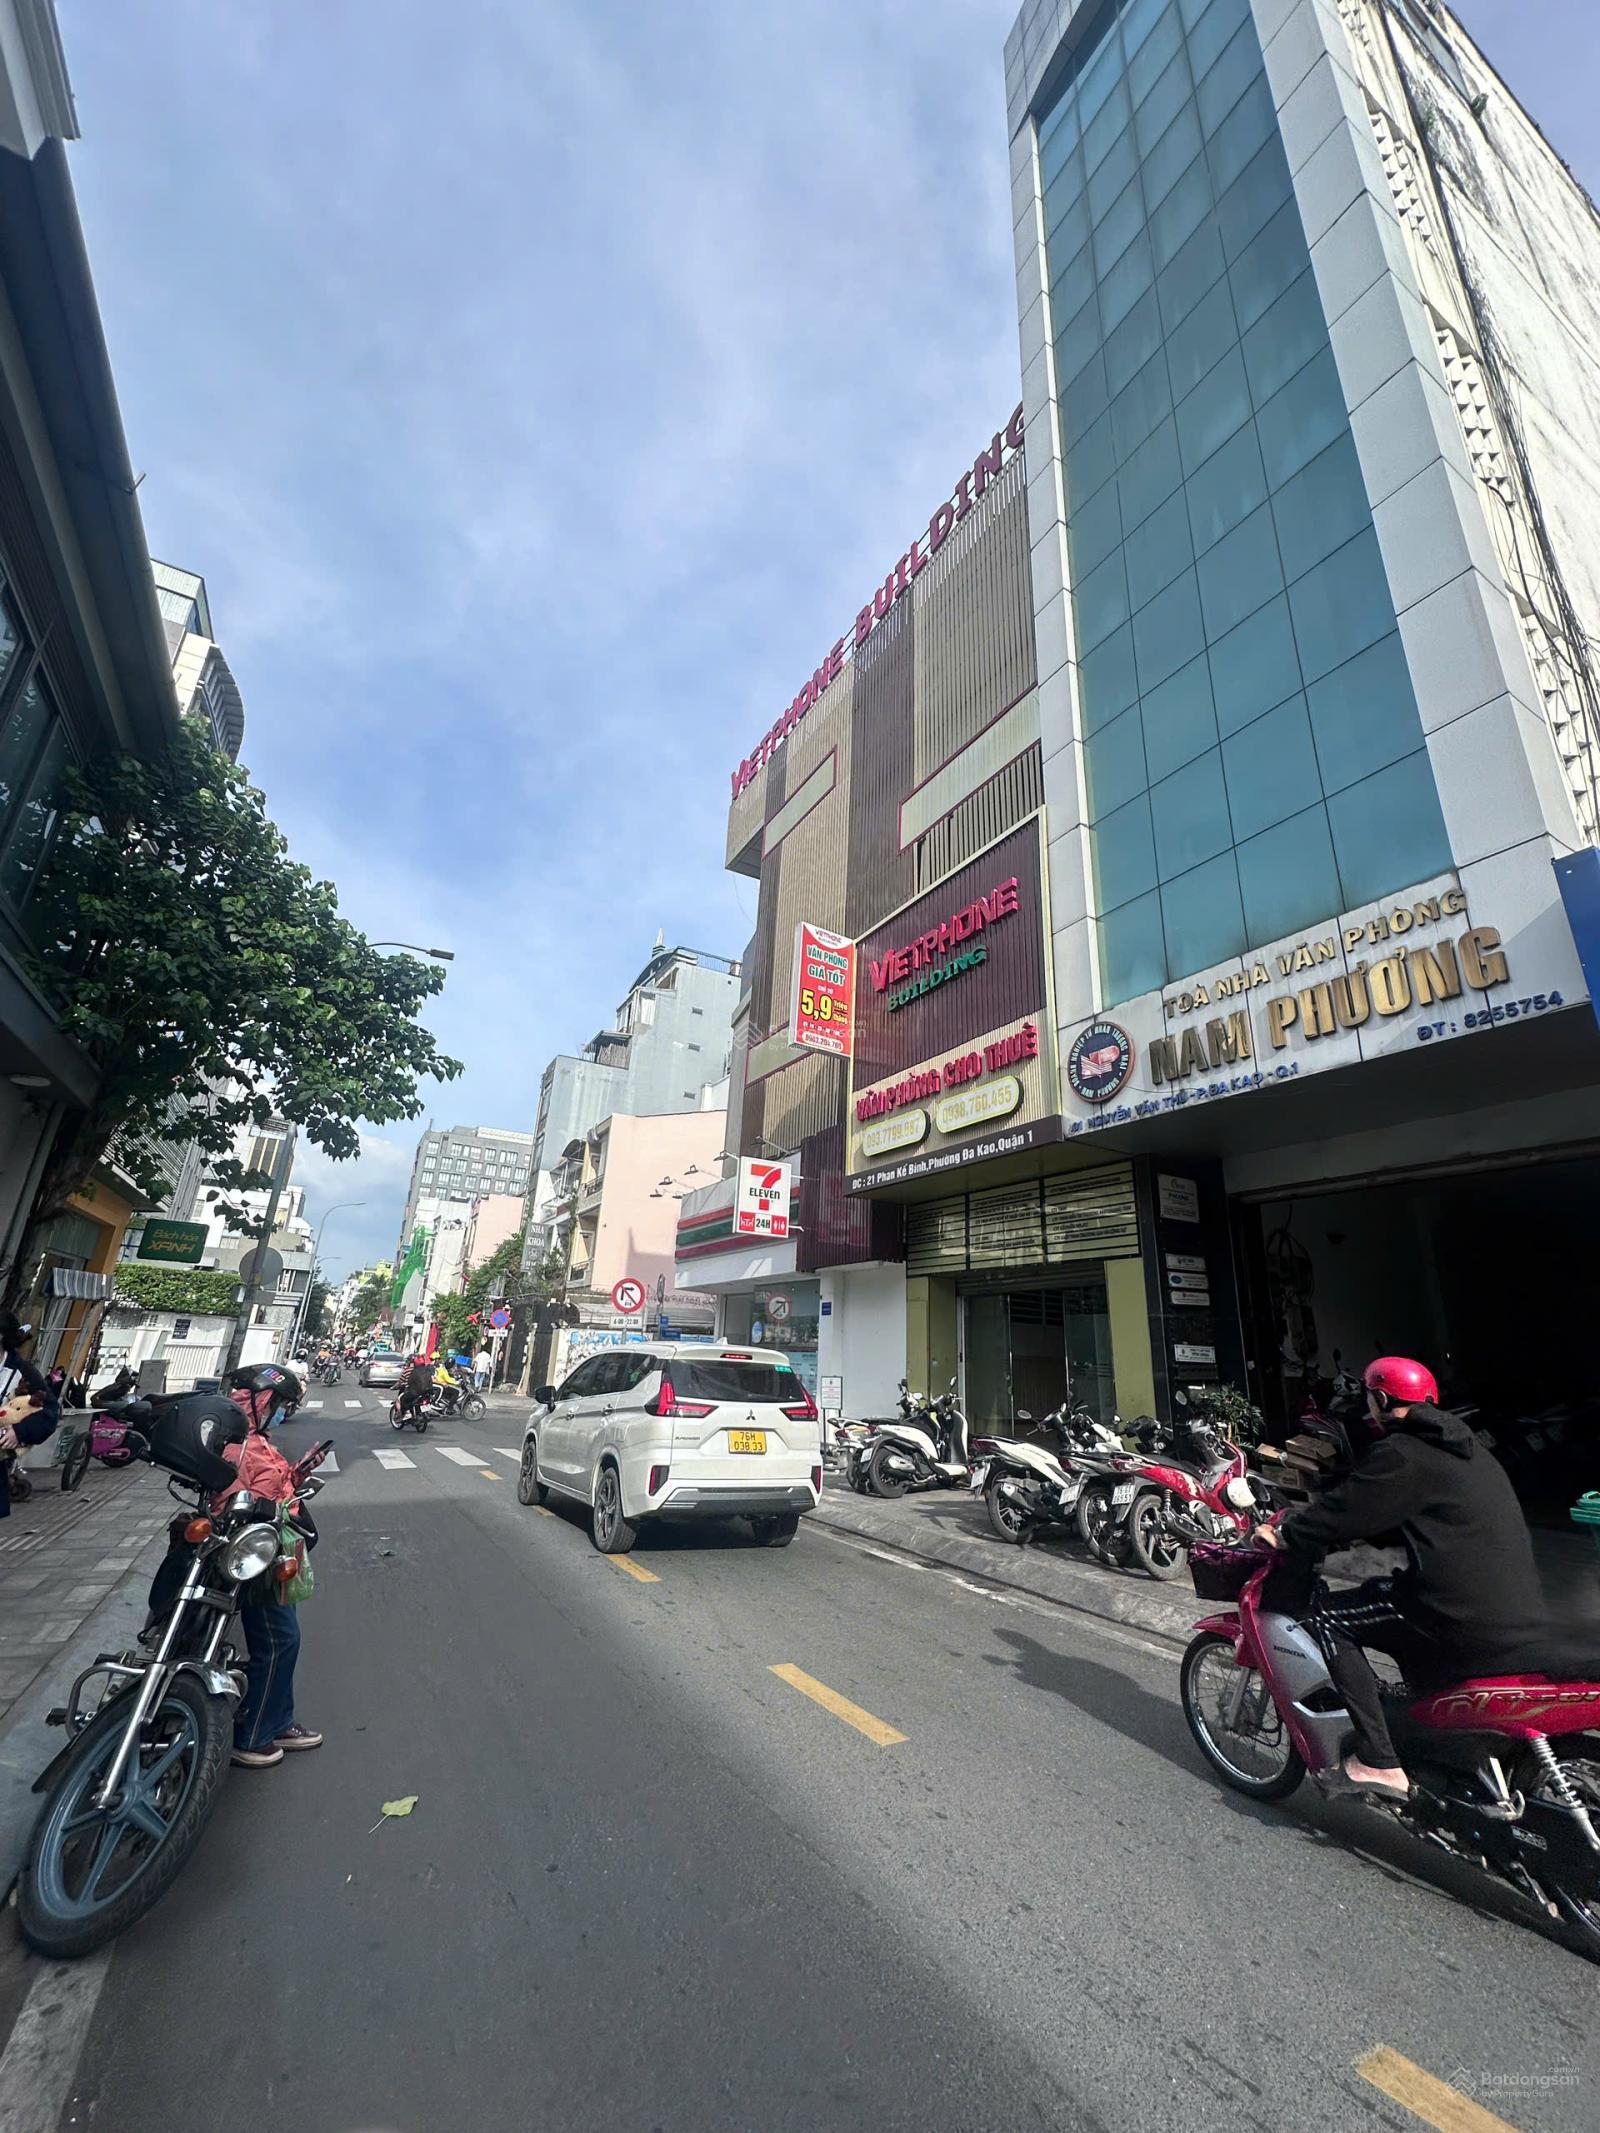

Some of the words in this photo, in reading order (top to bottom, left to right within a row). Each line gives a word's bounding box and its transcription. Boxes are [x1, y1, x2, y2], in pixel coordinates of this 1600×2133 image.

[731, 638, 844, 800] VIETPHONE
[856, 401, 1025, 648] BUILDING
[868, 876, 1018, 993] VIETPHONE
[1163, 984, 1211, 1018] TOÀ
[1215, 962, 1270, 1000] NHÀ
[1275, 937, 1336, 976] VĂN
[1343, 889, 1468, 952] PHÒNG
[808, 964, 825, 981] GIÁ
[827, 969, 845, 986] TỐT
[888, 945, 988, 1012] BUILDING
[801, 988, 832, 1021] 5,9
[1149, 1009, 1252, 1086] NAM
[1267, 927, 1512, 1049] PHƯƠNG
[1464, 990, 1564, 1029] 8255754
[886, 1070, 940, 1111] PHÒNG
[943, 1052, 982, 1086] CHO
[984, 1023, 1039, 1072] THUÊ
[867, 1175, 876, 1186] 21
[877, 1170, 896, 1184] Phan
[896, 1163, 908, 1177] Kế
[962, 1148, 975, 1160] Đa
[1027, 1130, 1033, 1143] 1
[527, 1237, 545, 1248] KHOA
[756, 1218, 770, 1229] 24H
[734, 1441, 763, 1452] 038.33
[739, 1431, 756, 1441] 76H
[1273, 1644, 1307, 1659] HONDA
